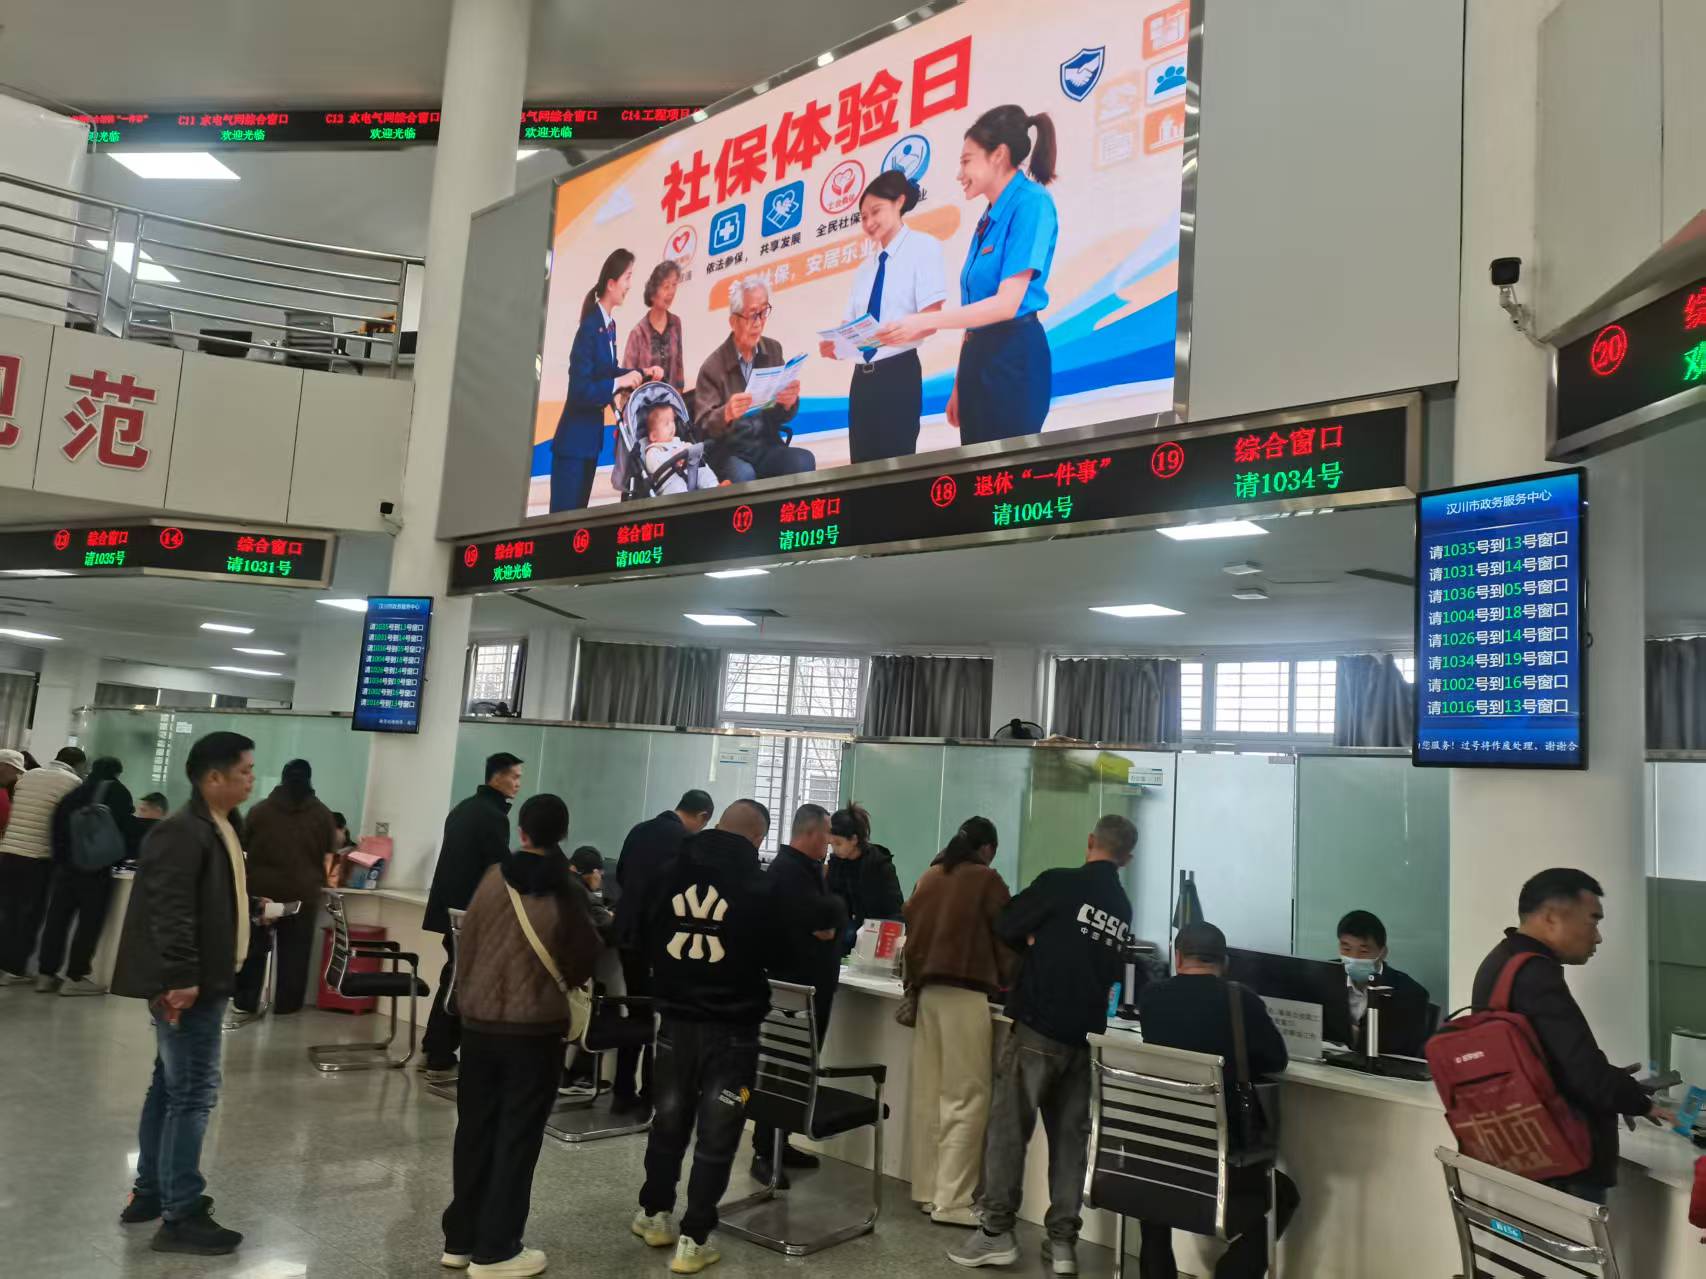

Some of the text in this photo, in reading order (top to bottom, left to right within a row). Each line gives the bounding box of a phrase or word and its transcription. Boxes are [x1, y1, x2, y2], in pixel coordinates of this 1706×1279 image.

[88, 130, 121, 143] 迎光临
[220, 128, 266, 142] 欢迎光临
[369, 127, 416, 140] 欢迎光临
[525, 126, 573, 139] 欢迎光临
[661, 35, 972, 224] 社保体验日
[759, 232, 802, 256] 共享发展
[816, 211, 861, 238] 全民社保
[1597, 333, 1622, 368] 20
[1234, 425, 1344, 463] 综合窗口
[1154, 449, 1181, 473] 19
[1233, 461, 1344, 499] 请1034号
[934, 482, 954, 503] 18
[1446, 489, 1553, 515] 汉川市政务服务中心
[735, 510, 750, 529] 17
[779, 498, 841, 523] 综合窗口
[992, 496, 1073, 526] 请1004号
[86, 530, 129, 546] 综合窗口
[162, 531, 182, 546] 14
[617, 523, 665, 545] 综合窗口
[779, 525, 839, 550] 请1019号
[237, 536, 303, 556] 综合窗口
[494, 542, 534, 561] 综合窗口
[1429, 531, 1568, 560] 请1035号到13号窗口
[84, 551, 126, 567] 请1035号
[227, 556, 292, 576] 请1031号
[616, 546, 663, 568] 请1002号
[493, 562, 533, 581] 欢迎光临
[1429, 555, 1568, 582] 请1031号到14号窗口
[1428, 578, 1568, 604] 请1036号到05号窗口
[1428, 602, 1568, 626] 请1004号到18号窗口
[1428, 626, 1568, 648] 请1026号到14号窗口
[1428, 650, 1568, 671] 请1034号到19号窗口
[1428, 674, 1568, 693] 请1002号到16号窗口
[1427, 698, 1568, 716] 请1016号到13号窗口
[1077, 903, 1129, 942] CSSC
